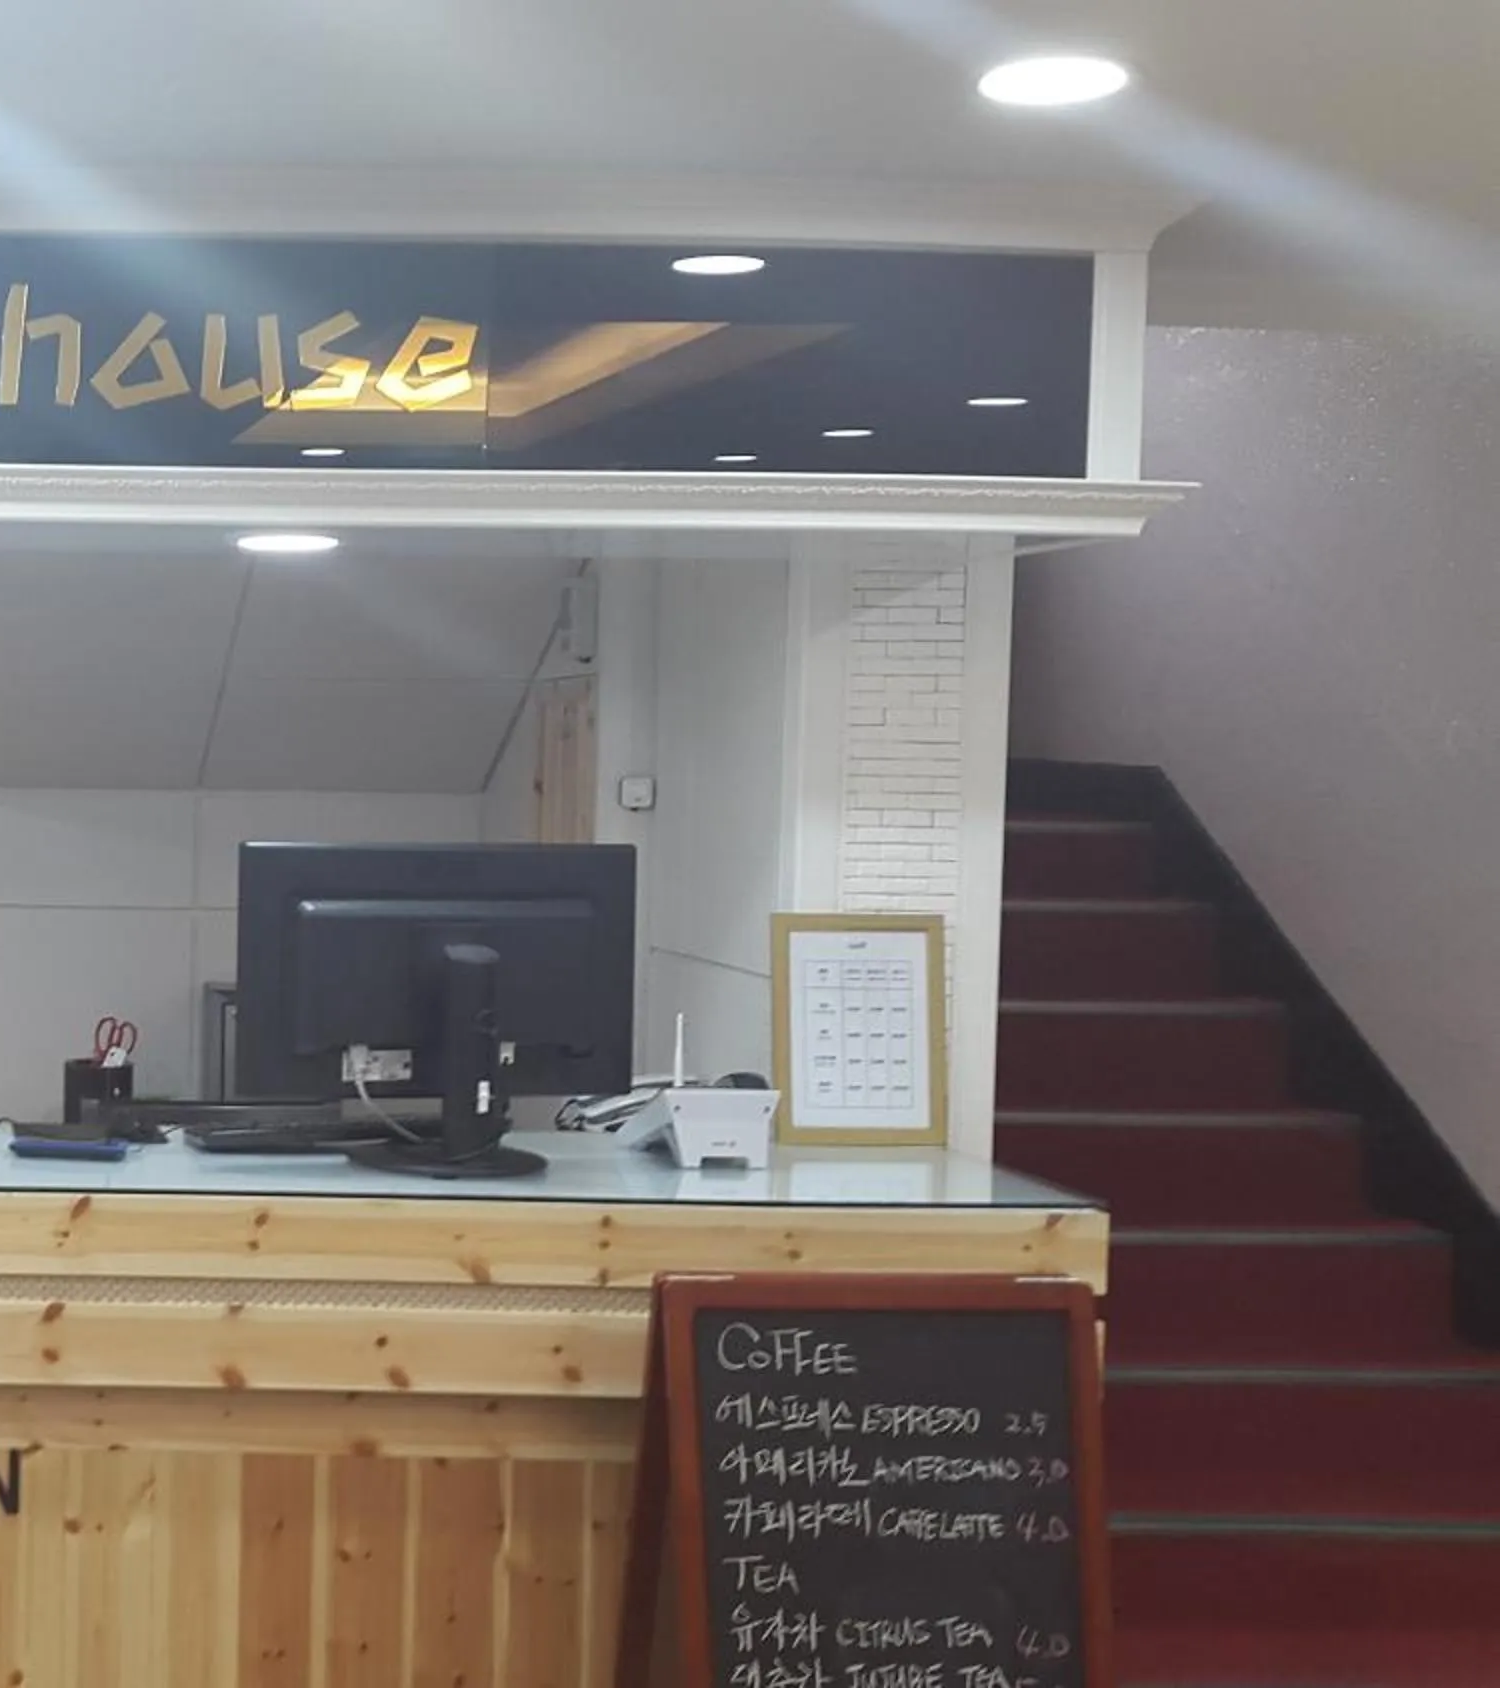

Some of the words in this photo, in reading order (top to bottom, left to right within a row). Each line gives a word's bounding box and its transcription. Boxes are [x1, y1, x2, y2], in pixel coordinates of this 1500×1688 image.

[715, 1391, 857, 1442] 에스프레소
[861, 1403, 982, 1438] ESPRESSO
[1003, 1411, 1049, 1437] 2.5
[718, 1441, 871, 1488] 아메리카노
[873, 1455, 1023, 1484] AMERICANO
[1027, 1456, 1070, 1489] 3.0
[1015, 1512, 1070, 1543] 4.0
[722, 1554, 801, 1596] TEA
[729, 1601, 827, 1652] 유자차
[834, 1616, 932, 1651] CITRUS
[936, 1615, 995, 1649] TEA
[1015, 1624, 1071, 1658] 4.0
